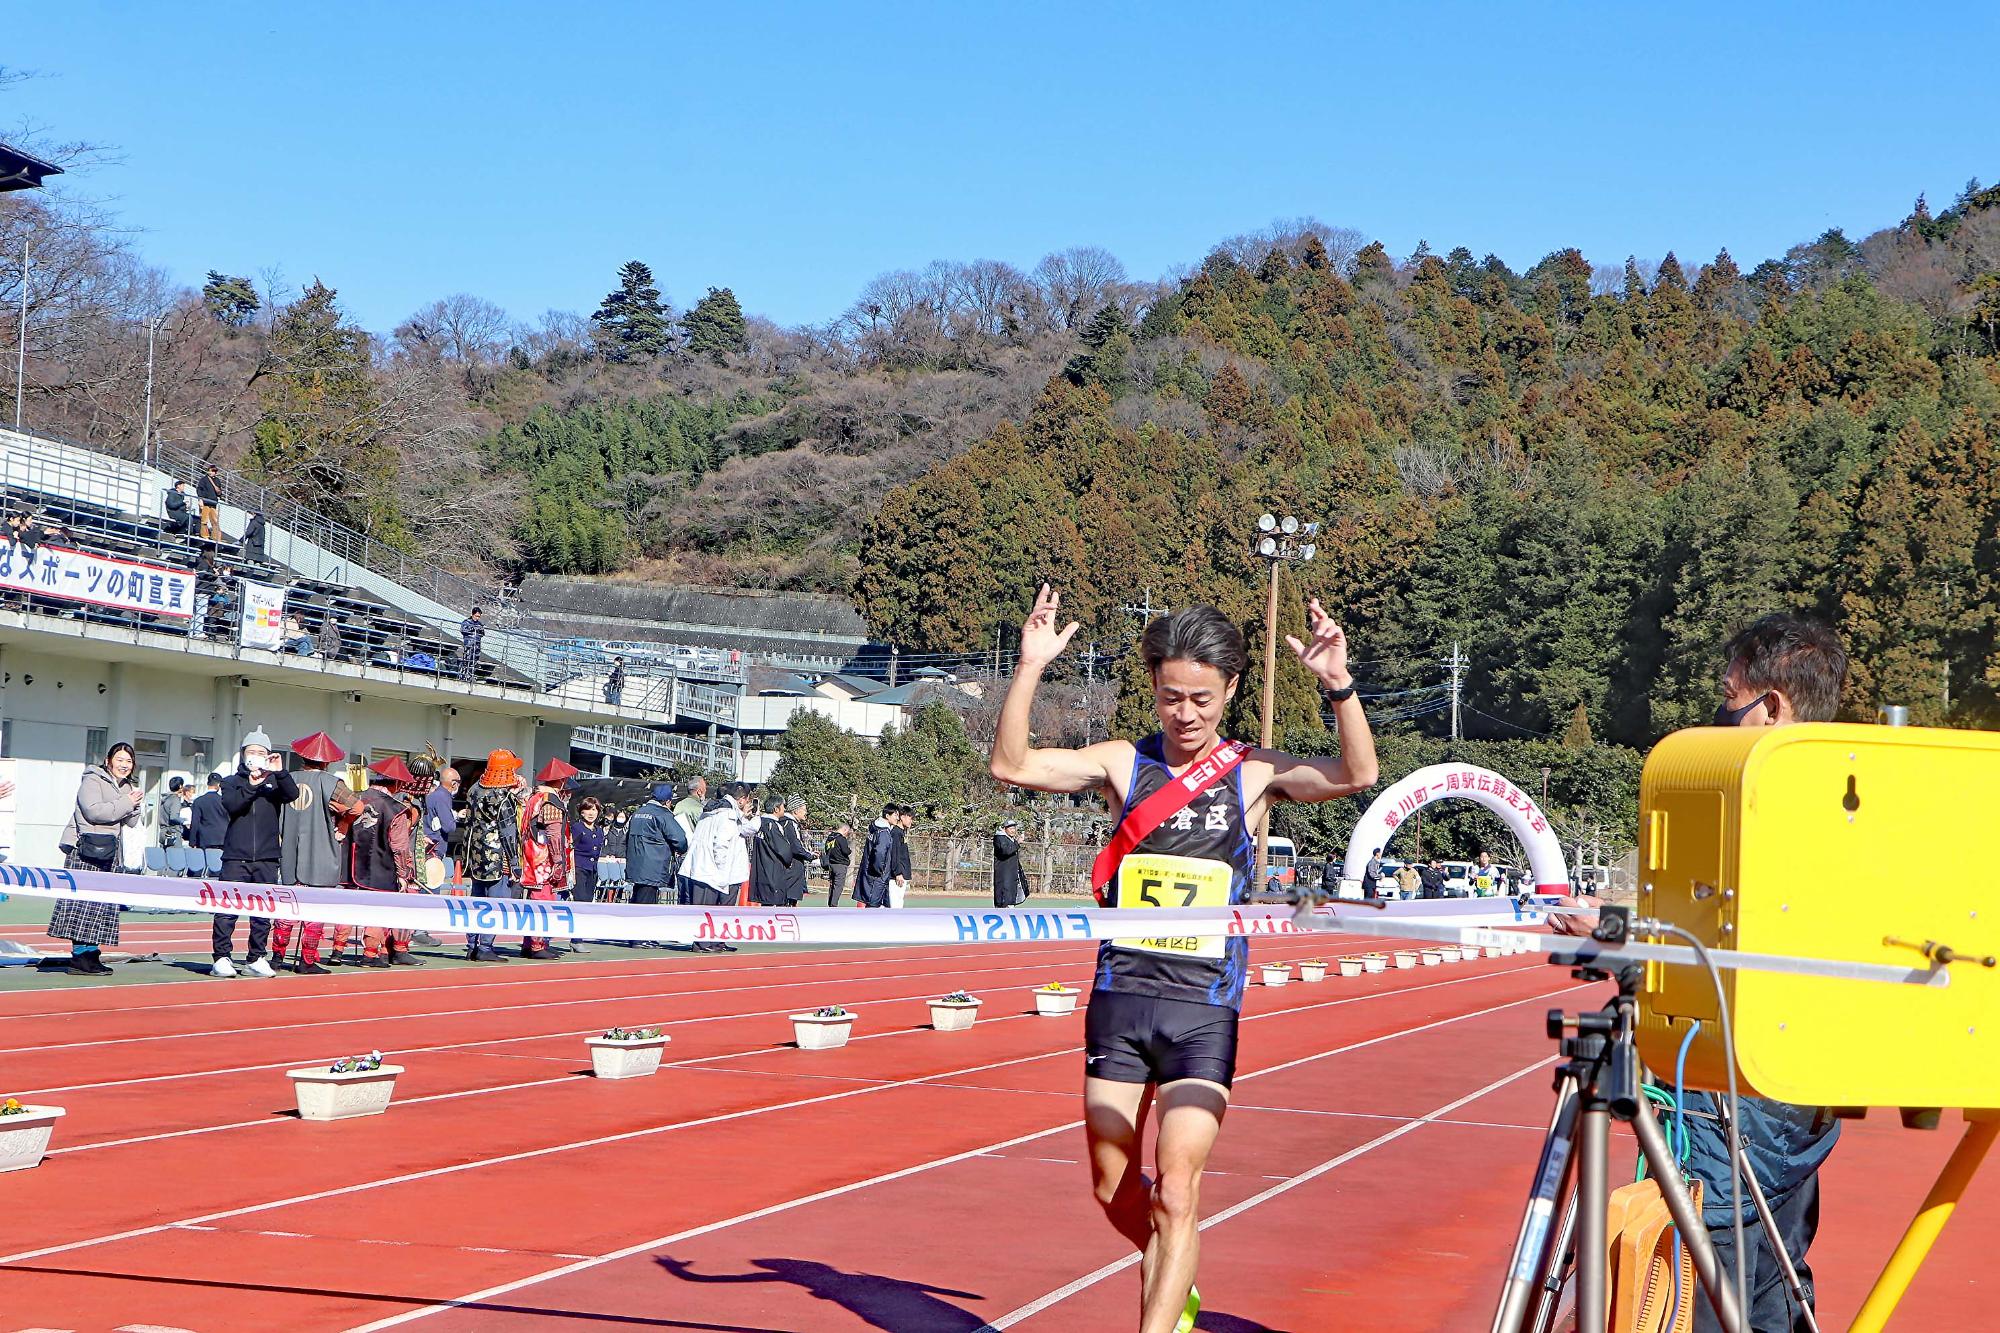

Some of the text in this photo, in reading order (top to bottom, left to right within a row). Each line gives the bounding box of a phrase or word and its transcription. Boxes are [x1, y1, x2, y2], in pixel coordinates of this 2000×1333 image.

[1384, 772, 1547, 833] 愛川町一周駅伝競走大会
[1160, 804, 1230, 831] 倉区
[1140, 879, 1198, 907] 57
